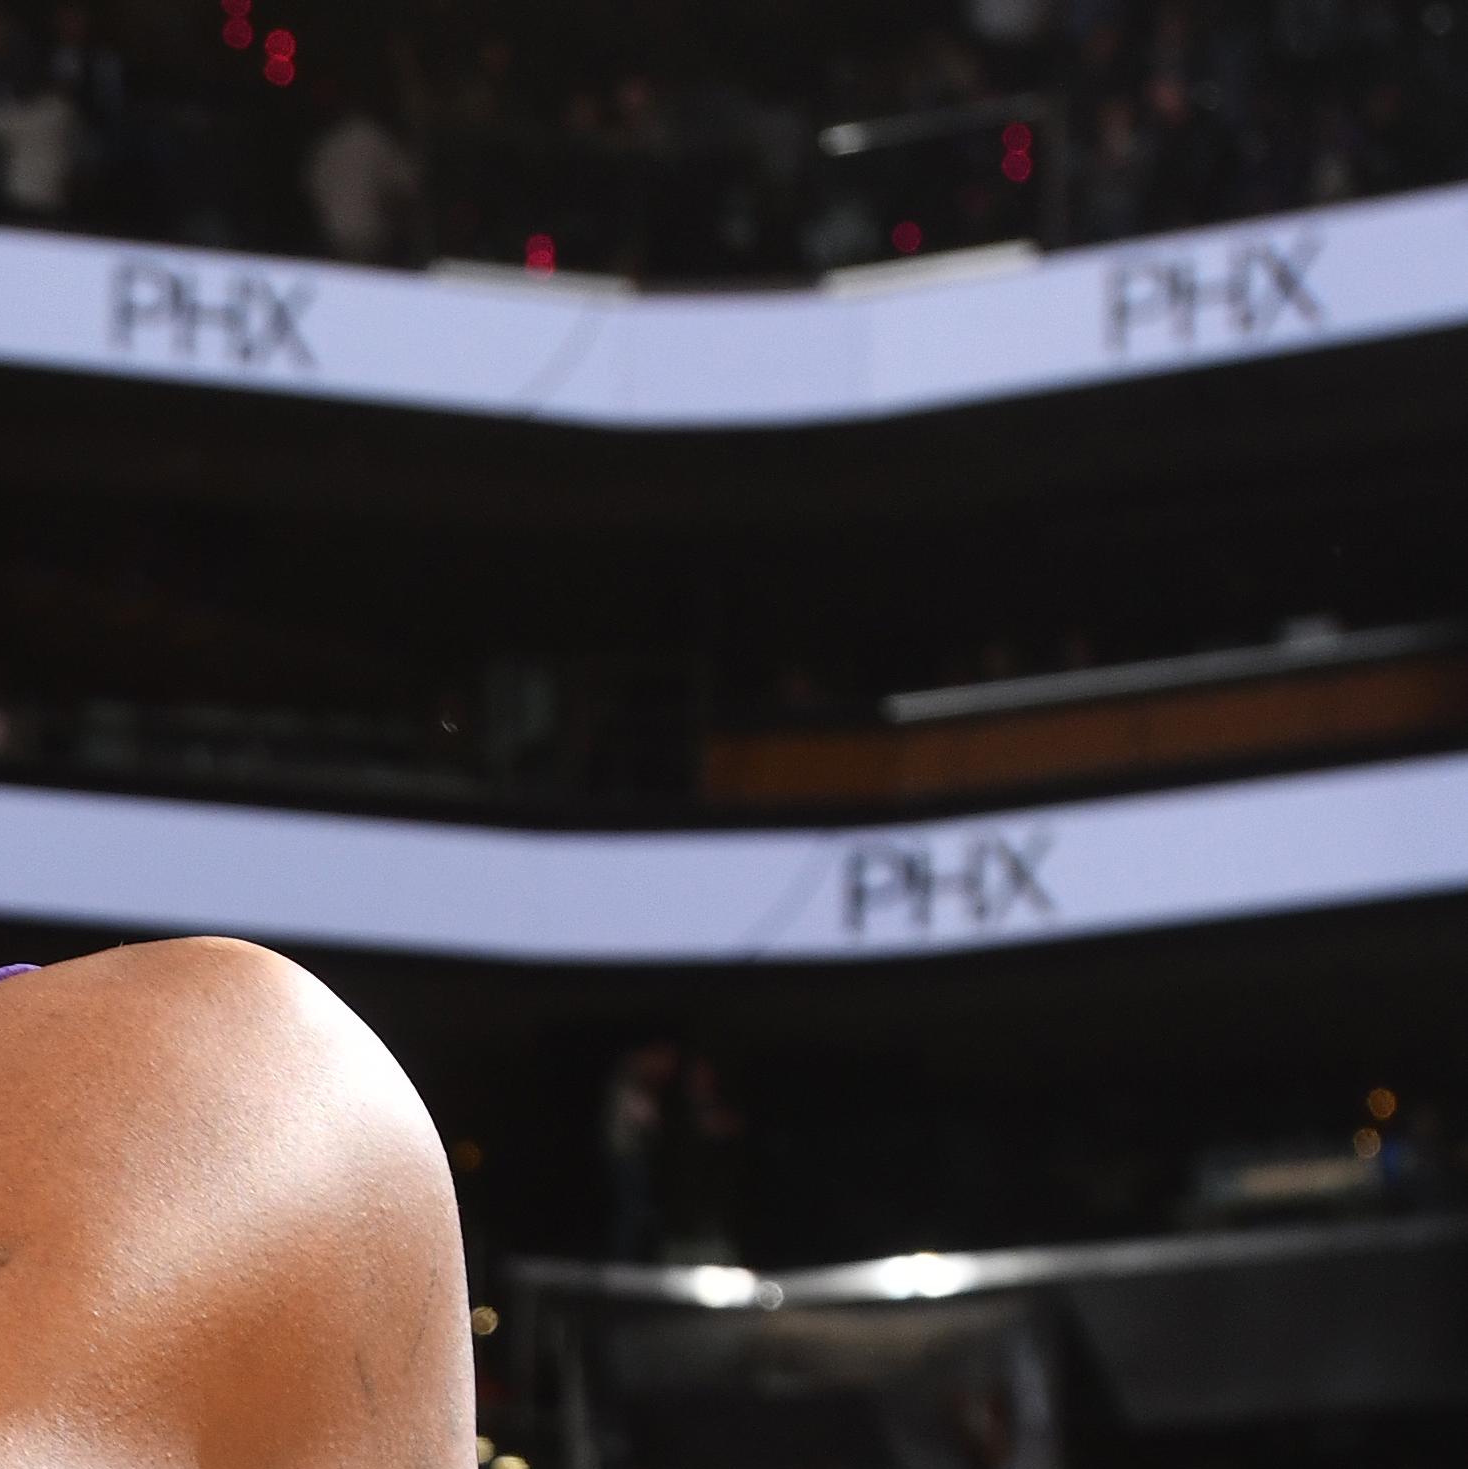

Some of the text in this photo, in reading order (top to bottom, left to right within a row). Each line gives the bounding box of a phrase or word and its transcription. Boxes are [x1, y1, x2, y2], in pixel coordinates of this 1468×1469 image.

[108, 254, 319, 370] PHX
[1103, 220, 1327, 350] PHX
[841, 817, 1057, 934] PHX
